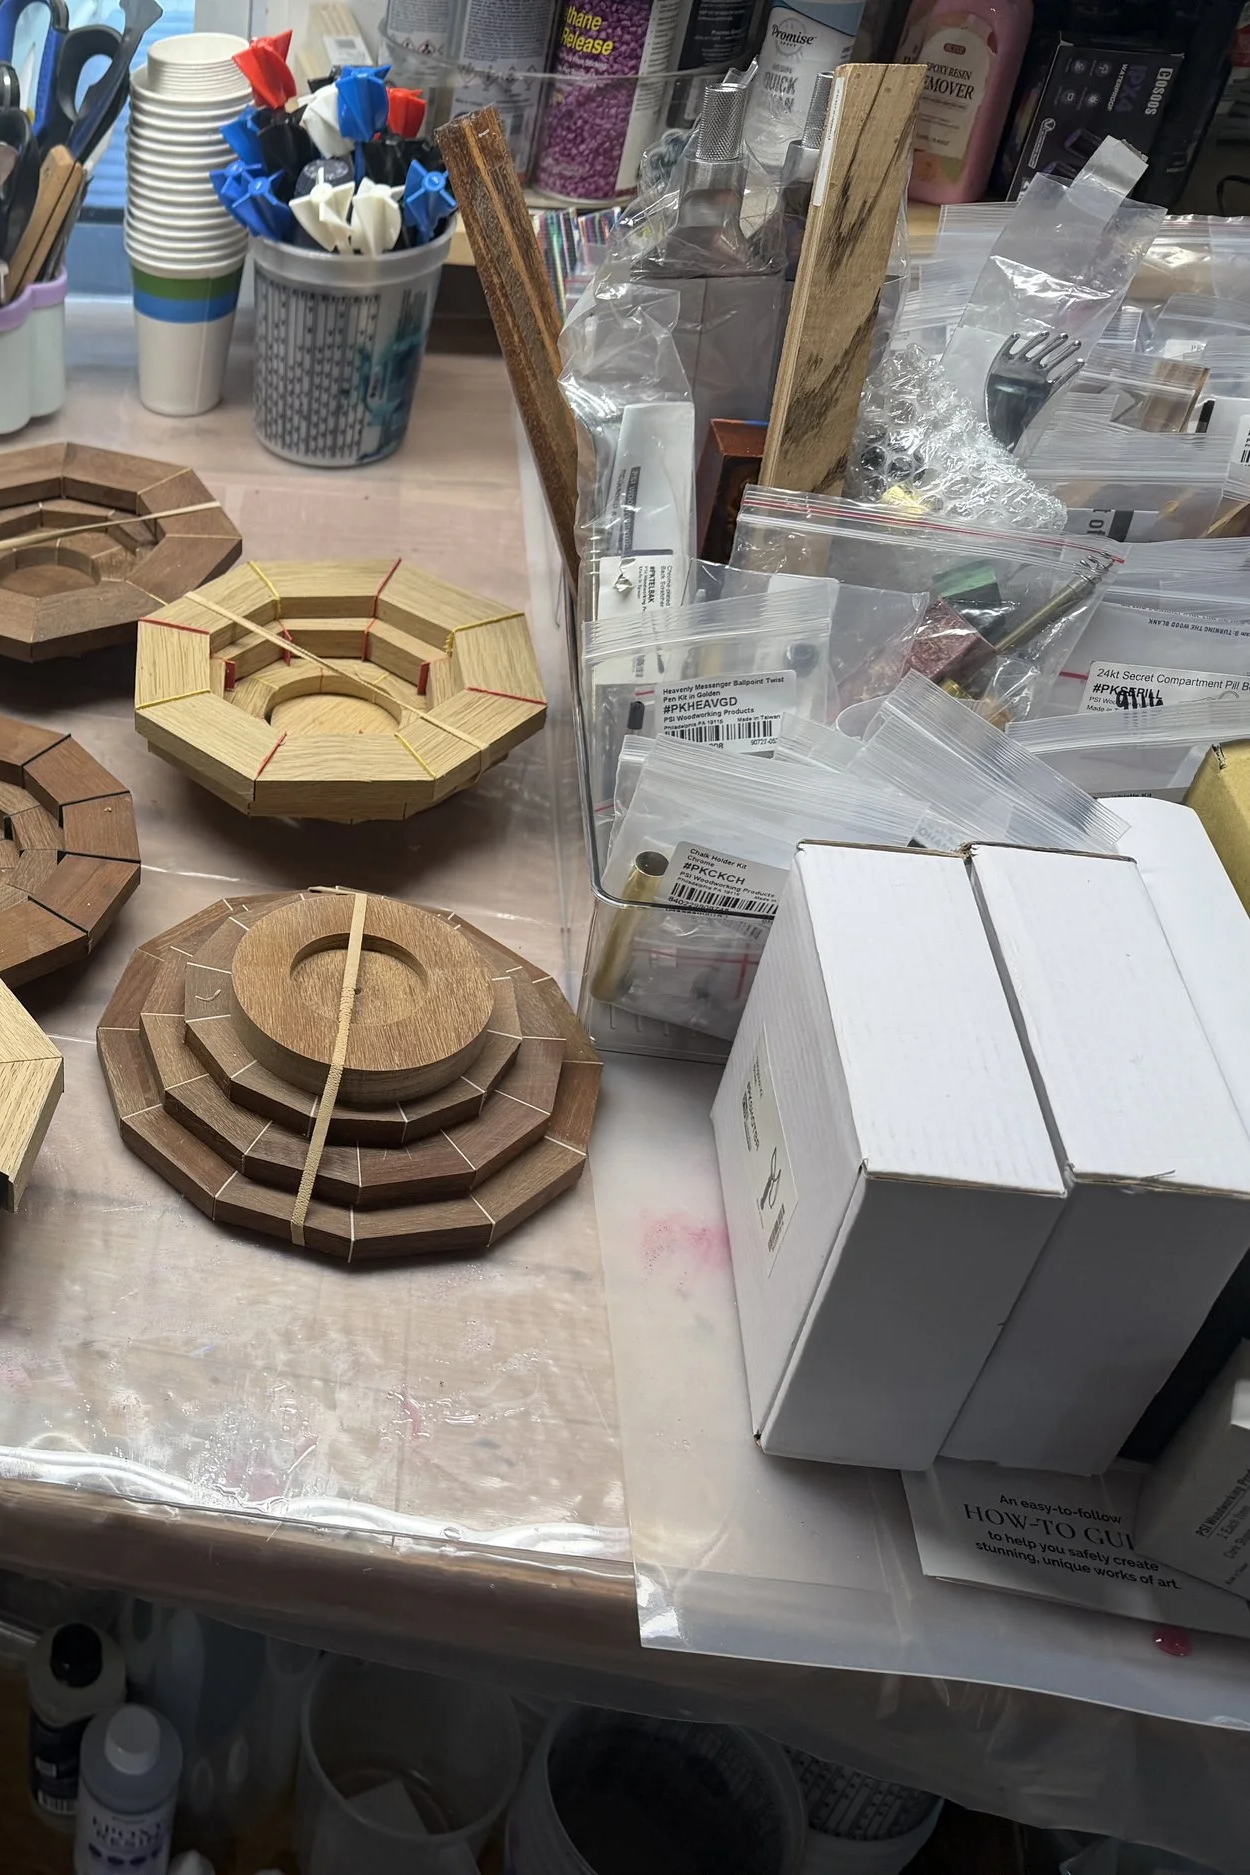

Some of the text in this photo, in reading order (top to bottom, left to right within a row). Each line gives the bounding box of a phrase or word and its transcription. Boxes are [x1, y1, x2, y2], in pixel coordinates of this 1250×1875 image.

[561, 26, 614, 56] Release
[771, 24, 815, 45] Promise
[1107, 63, 1129, 112] WATERPROOF
[1148, 618, 1170, 627] BLANK
[1171, 620, 1190, 630] WOOD
[1190, 624, 1203, 632] THE
[1204, 626, 1232, 636] TURNING
[663, 676, 785, 696] Heavenly Messenger Ballpoint Twist
[1096, 668, 1120, 679] 24kt
[1122, 671, 1154, 683] Secret
[1156, 674, 1223, 689] Compartment
[1225, 680, 1240, 690] Pill
[696, 690, 721, 698] Golden
[663, 697, 738, 714] #PKHEAVGD
[676, 710, 722, 721] Woodworking
[723, 707, 755, 716] Products
[687, 854, 715, 868] Chrome
[690, 848, 748, 870] Chalk Holder Kit
[679, 870, 775, 898] PSI Woodworking Products
[682, 862, 746, 885] #PKCKCH
[999, 1493, 1122, 1525] An easy-to-follow
[963, 1503, 1135, 1551] HOW-TO GUI
[1195, 1522, 1212, 1538] PSI
[987, 1530, 1160, 1573] to help you safely create
[975, 1540, 1182, 1590] stunning, unique works of art.
